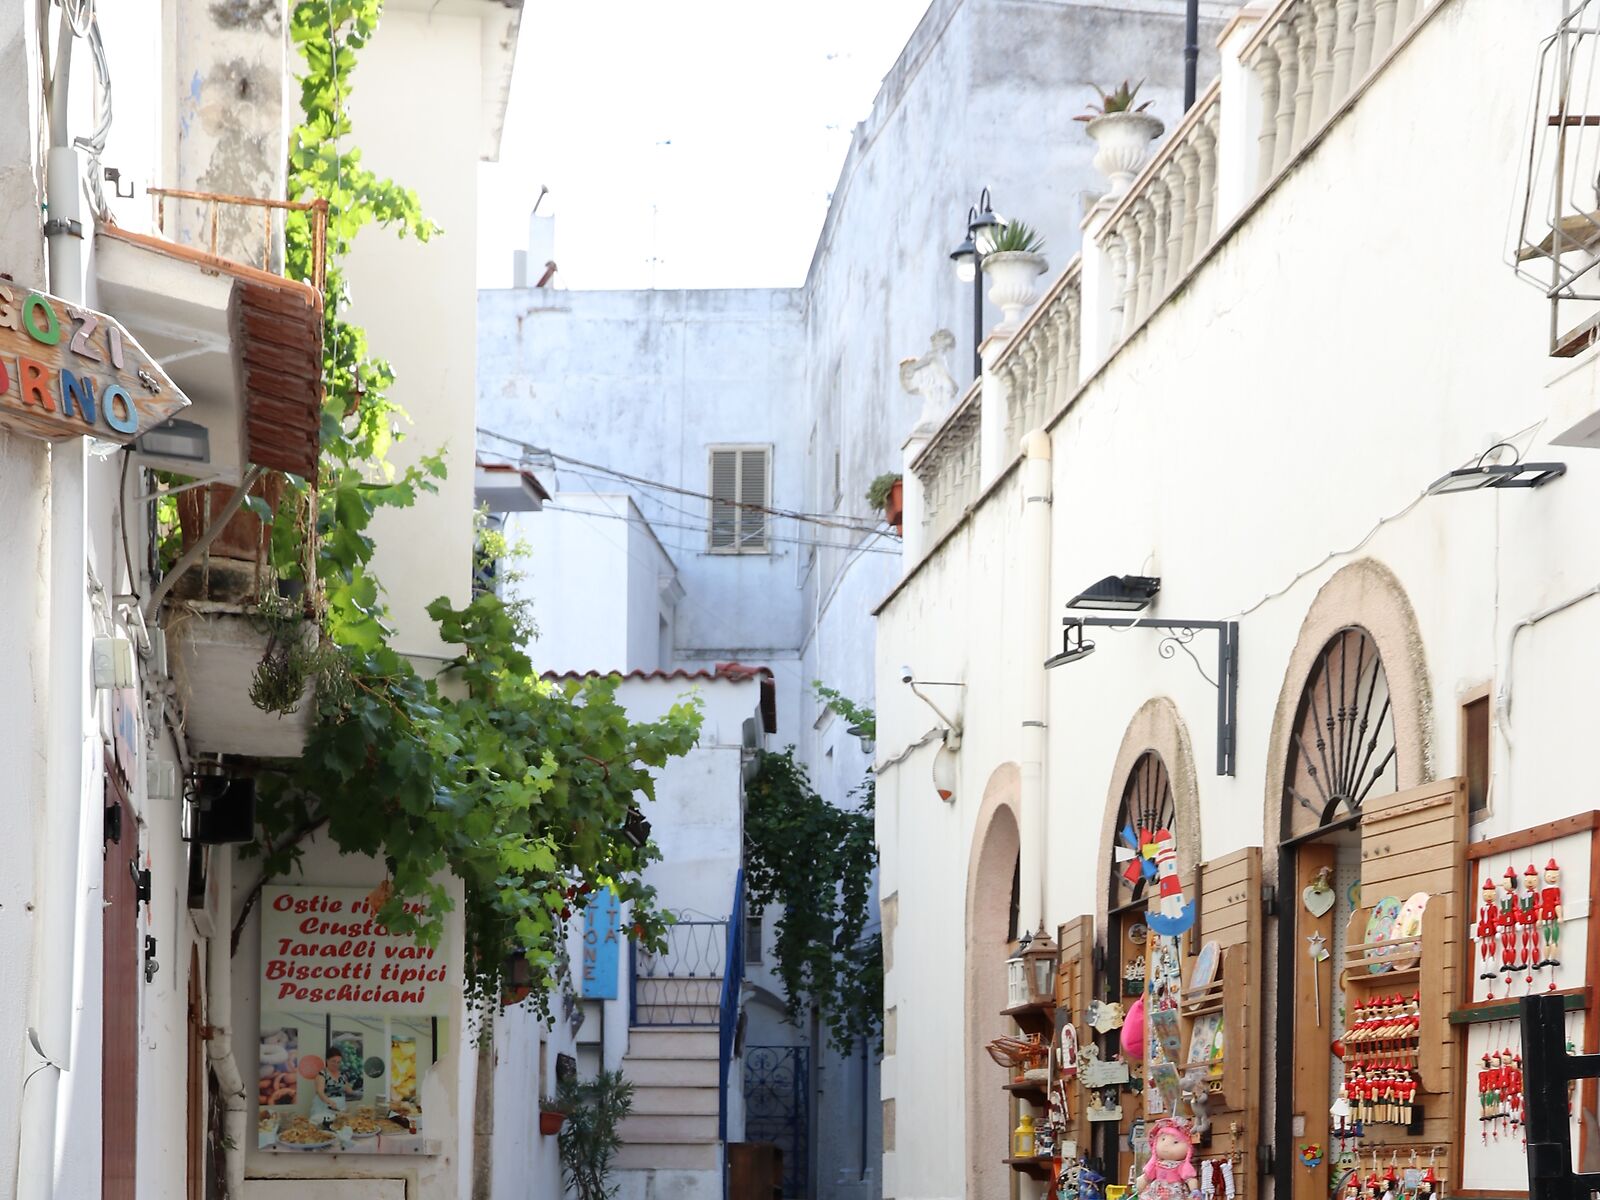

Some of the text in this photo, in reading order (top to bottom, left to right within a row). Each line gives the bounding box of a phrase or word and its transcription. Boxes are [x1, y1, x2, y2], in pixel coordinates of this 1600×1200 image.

[0, 354, 139, 434] RNO
[272, 894, 342, 914] Ostie
[299, 916, 413, 937] Crusto
[278, 938, 434, 960] Taralli vari
[265, 960, 447, 985] Biscotti tipici
[278, 982, 425, 1003] Peschiciani
